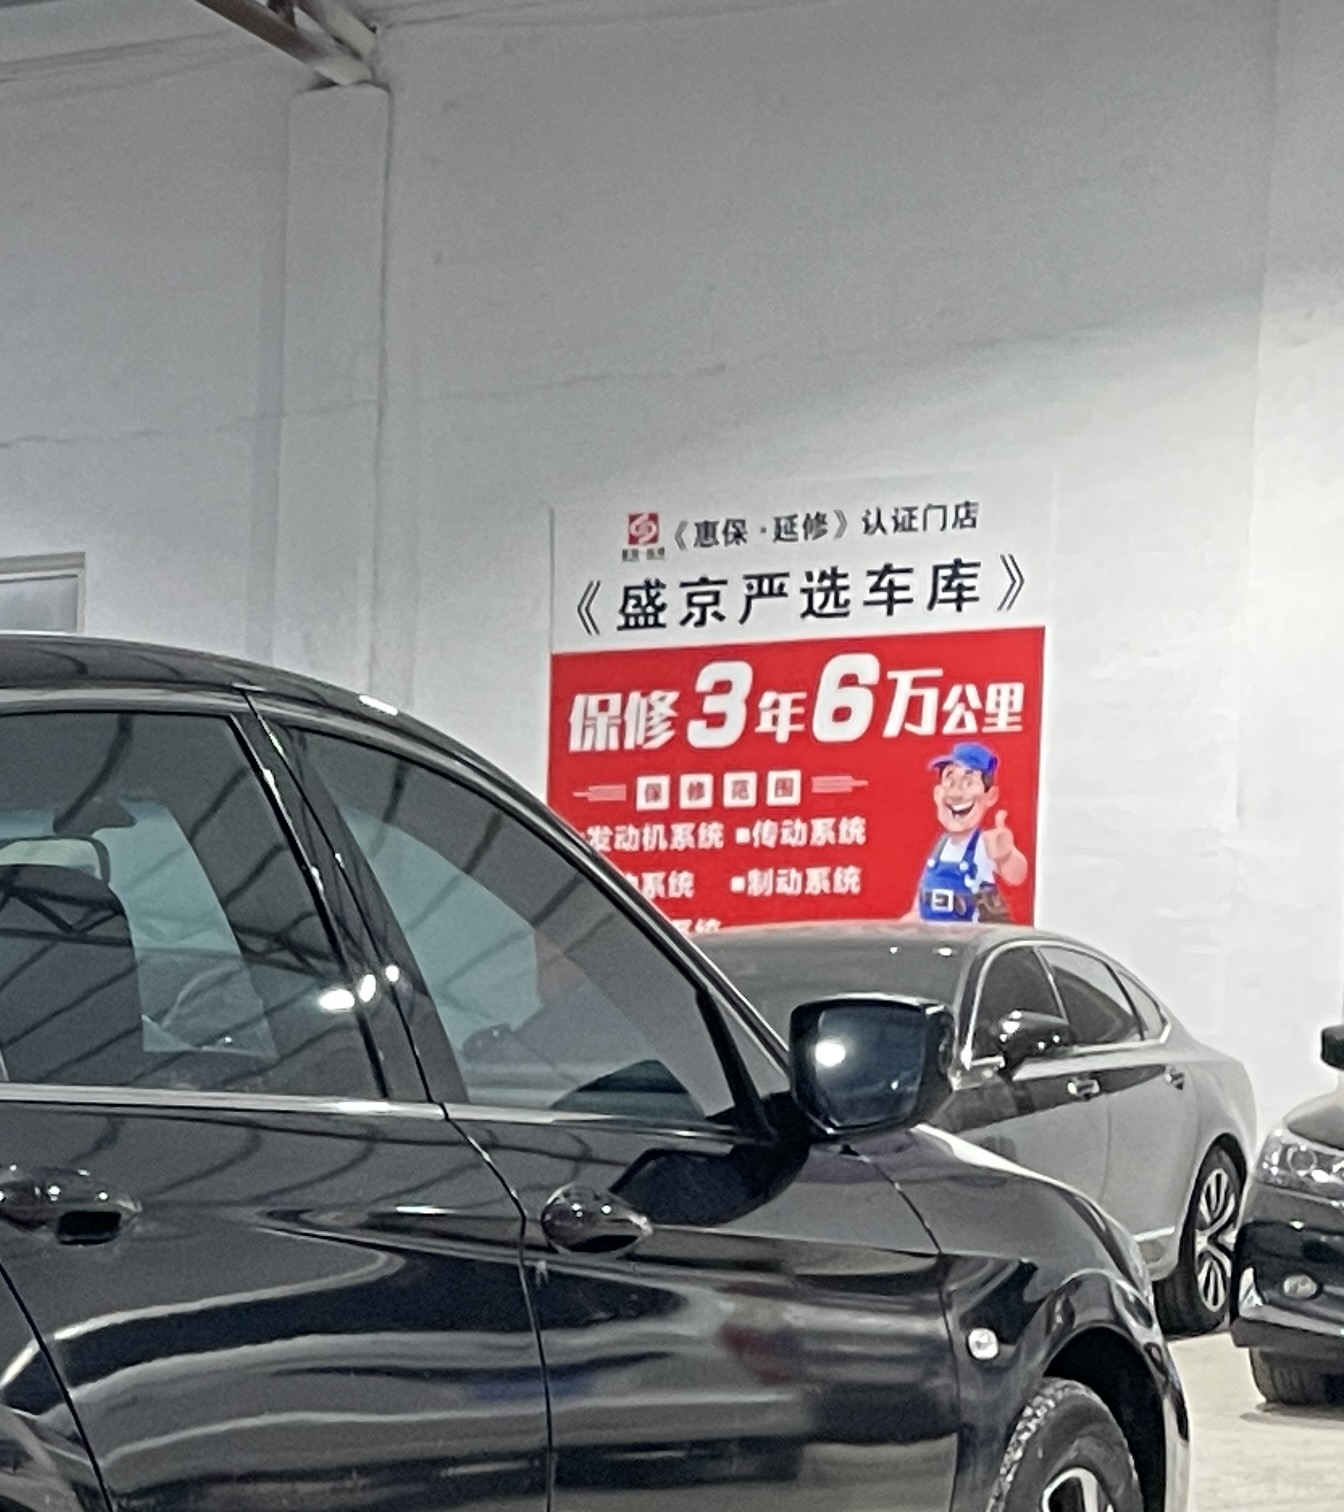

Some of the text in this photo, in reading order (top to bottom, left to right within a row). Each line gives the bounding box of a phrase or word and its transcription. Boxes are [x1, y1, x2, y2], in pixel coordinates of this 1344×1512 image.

[752, 816, 867, 848] 传动系统
[747, 866, 861, 896] 制动系统
